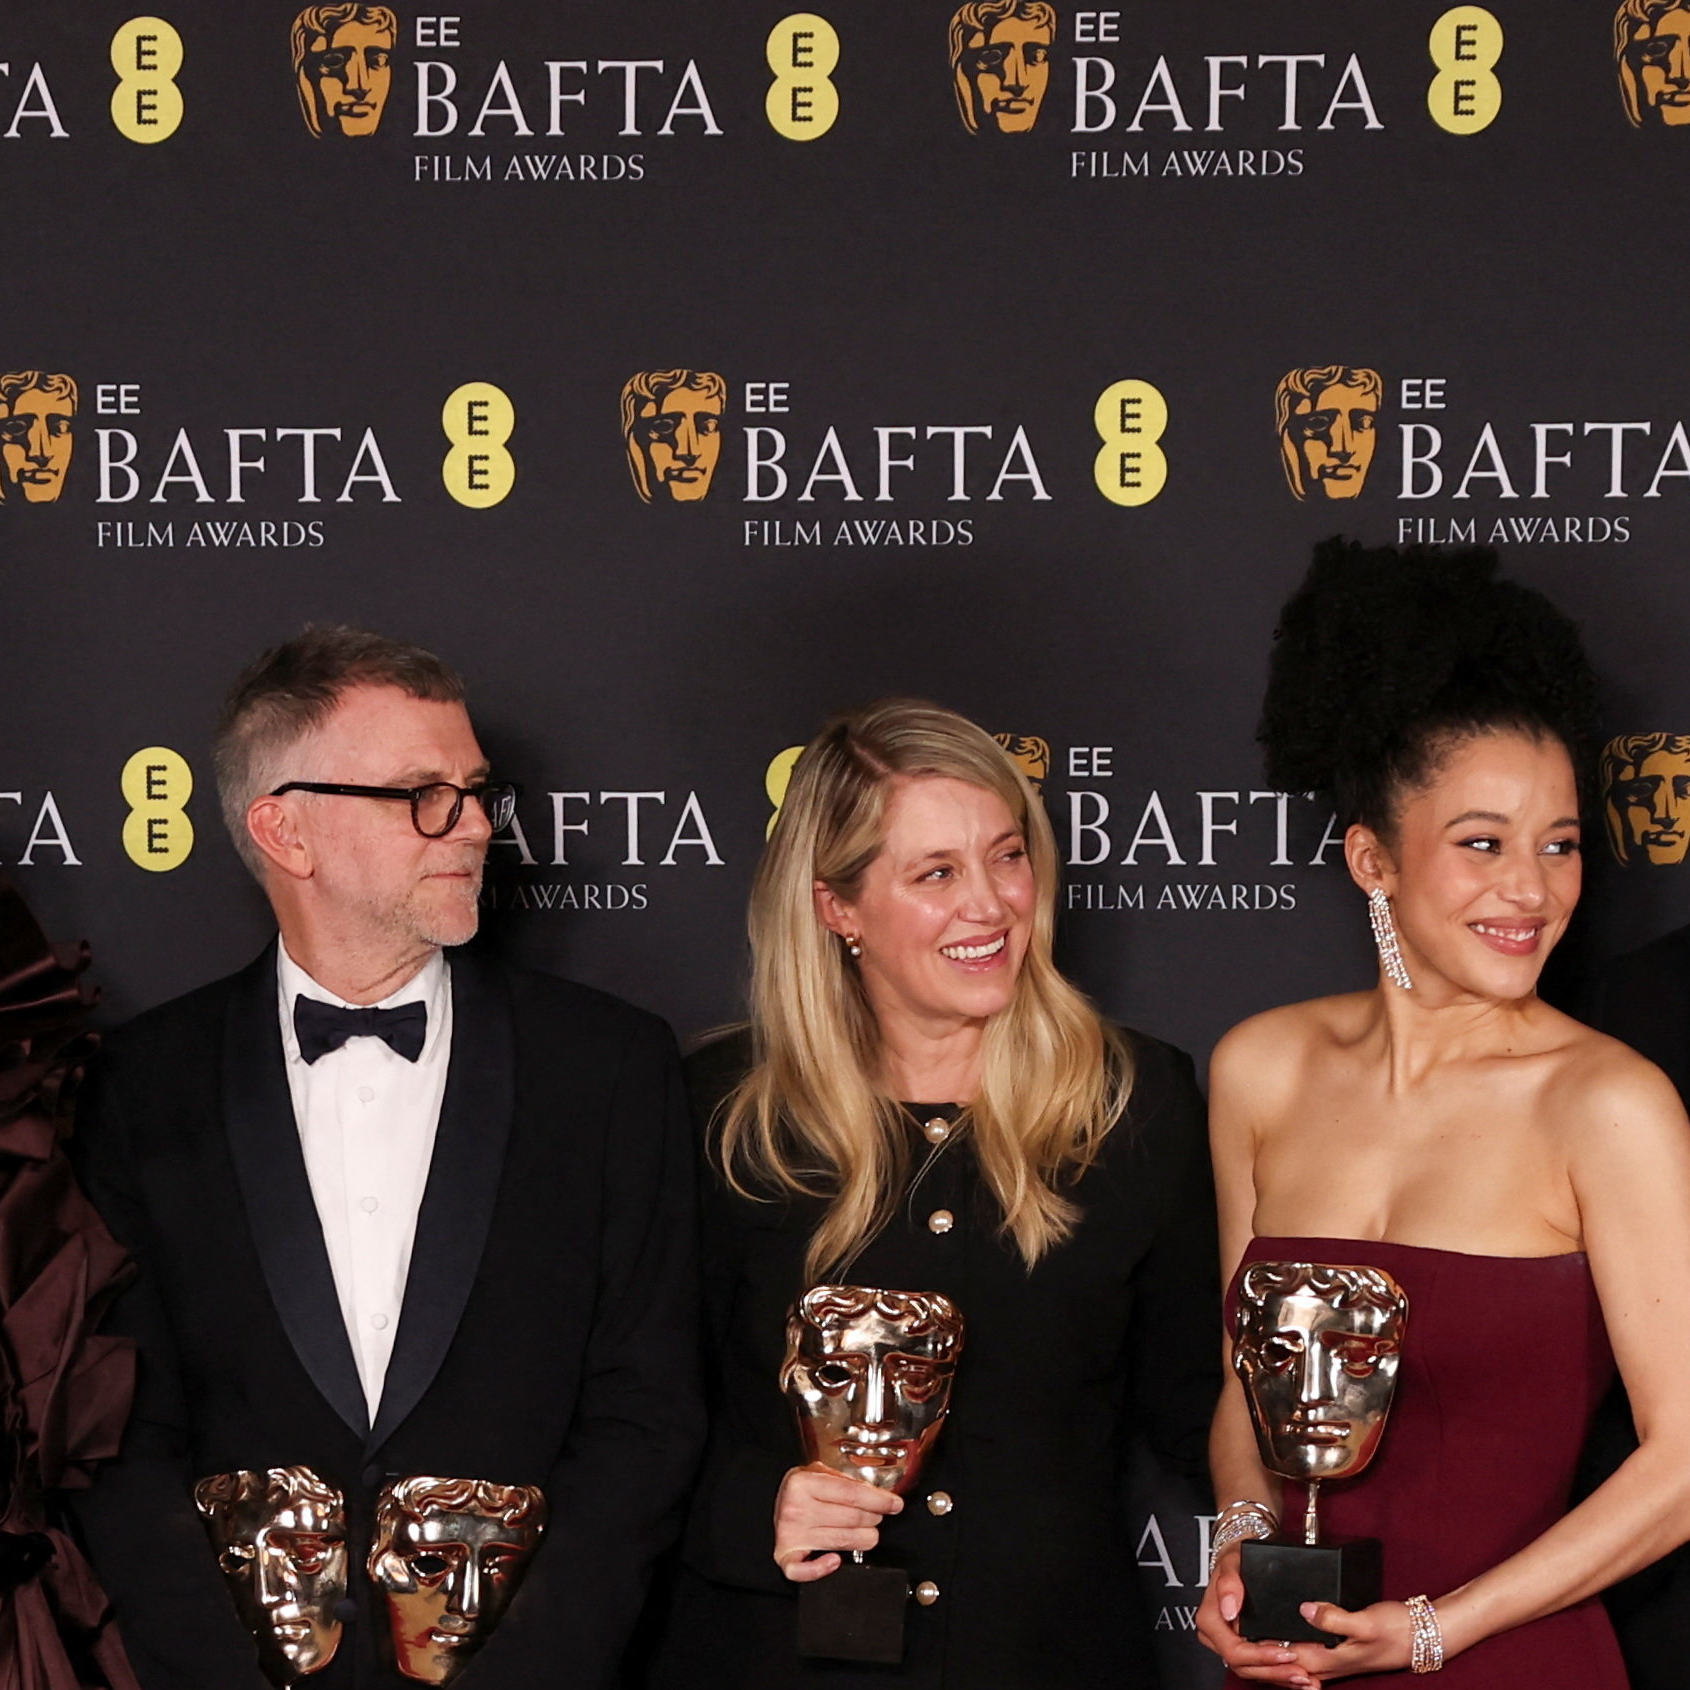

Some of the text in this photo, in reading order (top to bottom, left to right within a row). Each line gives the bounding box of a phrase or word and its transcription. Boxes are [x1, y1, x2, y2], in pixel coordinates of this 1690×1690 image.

[415, 16, 461, 47] EE
[1074, 11, 1121, 43] EE
[412, 58, 724, 137] BAFTA
[1070, 52, 1385, 133] BAFTA
[414, 154, 644, 182] FILM AWARDS
[1071, 149, 1304, 178] FILM AWARDS
[96, 384, 141, 415] EE
[745, 382, 790, 413] EE
[1400, 378, 1447, 410] EE
[94, 426, 403, 503] BAFTA
[742, 424, 1053, 502] BAFTA
[97, 520, 324, 548] FILM AWARDS
[744, 519, 974, 546] FILM AWARDS
[1398, 516, 1630, 544] FILM AWARDS
[1068, 746, 1114, 777] EE
[484, 790, 726, 866] AFTA
[514, 883, 648, 910] AWARDS
[1067, 883, 1296, 910] FILM AWARDS
